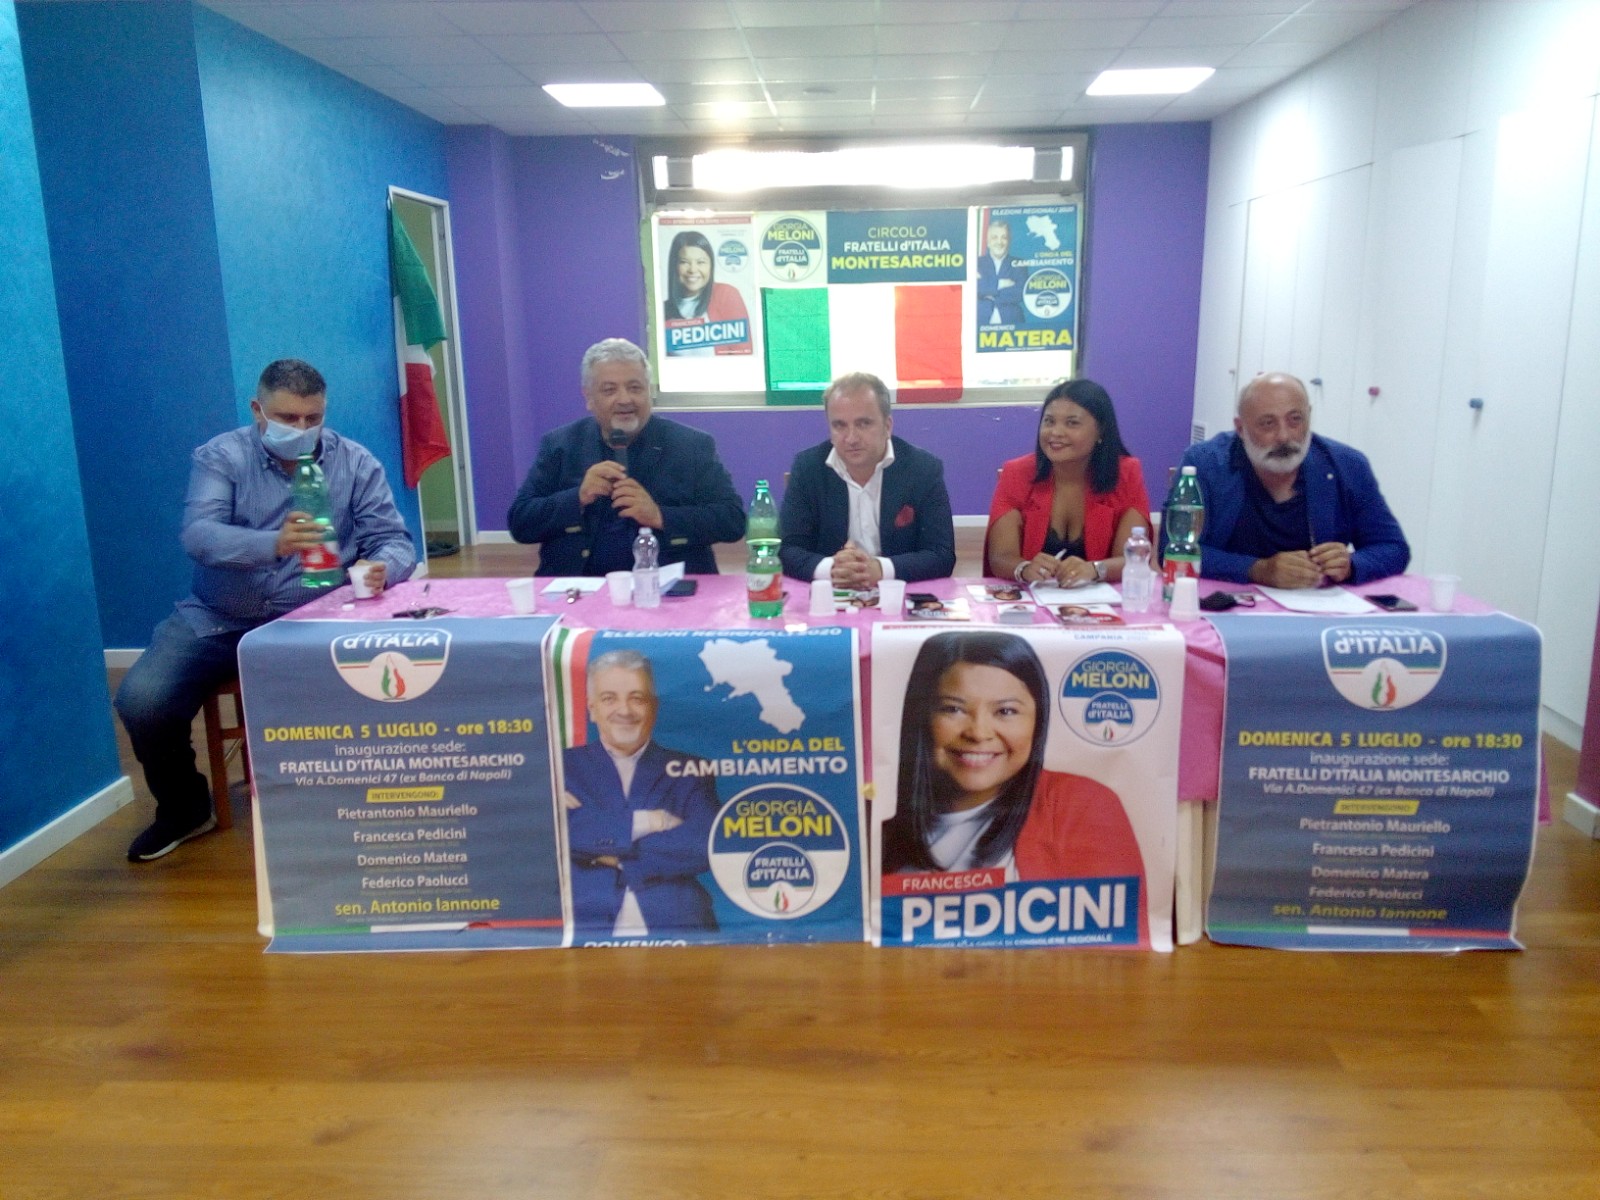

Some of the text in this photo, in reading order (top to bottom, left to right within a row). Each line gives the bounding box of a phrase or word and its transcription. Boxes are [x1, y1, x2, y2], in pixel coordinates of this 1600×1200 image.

[768, 230, 814, 241] MELONI
[868, 226, 927, 239] CIRCOLO
[844, 239, 951, 253] FRATELLI d'ITALIA
[831, 253, 964, 270] MONTESARCHIO
[1029, 280, 1067, 289] MELONI
[671, 321, 745, 346] PEDICINI
[979, 328, 1073, 348] MATERA
[1333, 635, 1437, 655] d'ITALIA
[1081, 660, 1139, 674] GIORGIA
[1071, 672, 1150, 690] MELONI
[1087, 708, 1132, 721] d'ITALIA
[1091, 701, 1130, 711] FRATELLI
[264, 724, 354, 742] DOMENICA
[361, 726, 370, 739] 5
[377, 722, 438, 739] LUGLIO
[457, 723, 484, 735] ore
[488, 719, 534, 735] 18:30
[732, 737, 846, 754] L'ONDA DEL
[1238, 730, 1333, 748] DOMENICA
[1340, 733, 1351, 748] 5
[1358, 731, 1423, 749] LUGLIO
[1442, 735, 1471, 748] ore
[1475, 734, 1523, 749] 18:30
[335, 741, 467, 759] inaugurazione sede:
[279, 753, 525, 774] FRATELLI D'ITALIA MONTESARCHIO
[665, 756, 848, 778] CAMBIAMENTO
[1310, 752, 1450, 769] inaugurazione sede:
[295, 769, 512, 787] Via A.Domenici 47 (ex Banco di Napoli)
[1249, 767, 1510, 783] FRATELLI D'ITALIA MONTESARCHIO
[337, 803, 478, 820] Pietrantonio Mauriello
[735, 799, 818, 817] GIORGIA
[723, 814, 833, 839] MELONI
[1299, 817, 1451, 834] Pietrantonio Mauriello
[353, 827, 467, 843] Francesca Pedicini
[1312, 842, 1435, 858] Francesca Pedicini
[357, 852, 468, 866] Domenico Matera
[754, 856, 806, 869] FRATELLI
[750, 866, 811, 882] d'ITALIA
[1311, 866, 1380, 879] Domenico
[362, 874, 469, 889] Federico Paolucci
[902, 872, 993, 892] FRANCESCA
[335, 898, 500, 916] sen. Antonio Iannone
[901, 883, 1127, 943] PEDICINI
